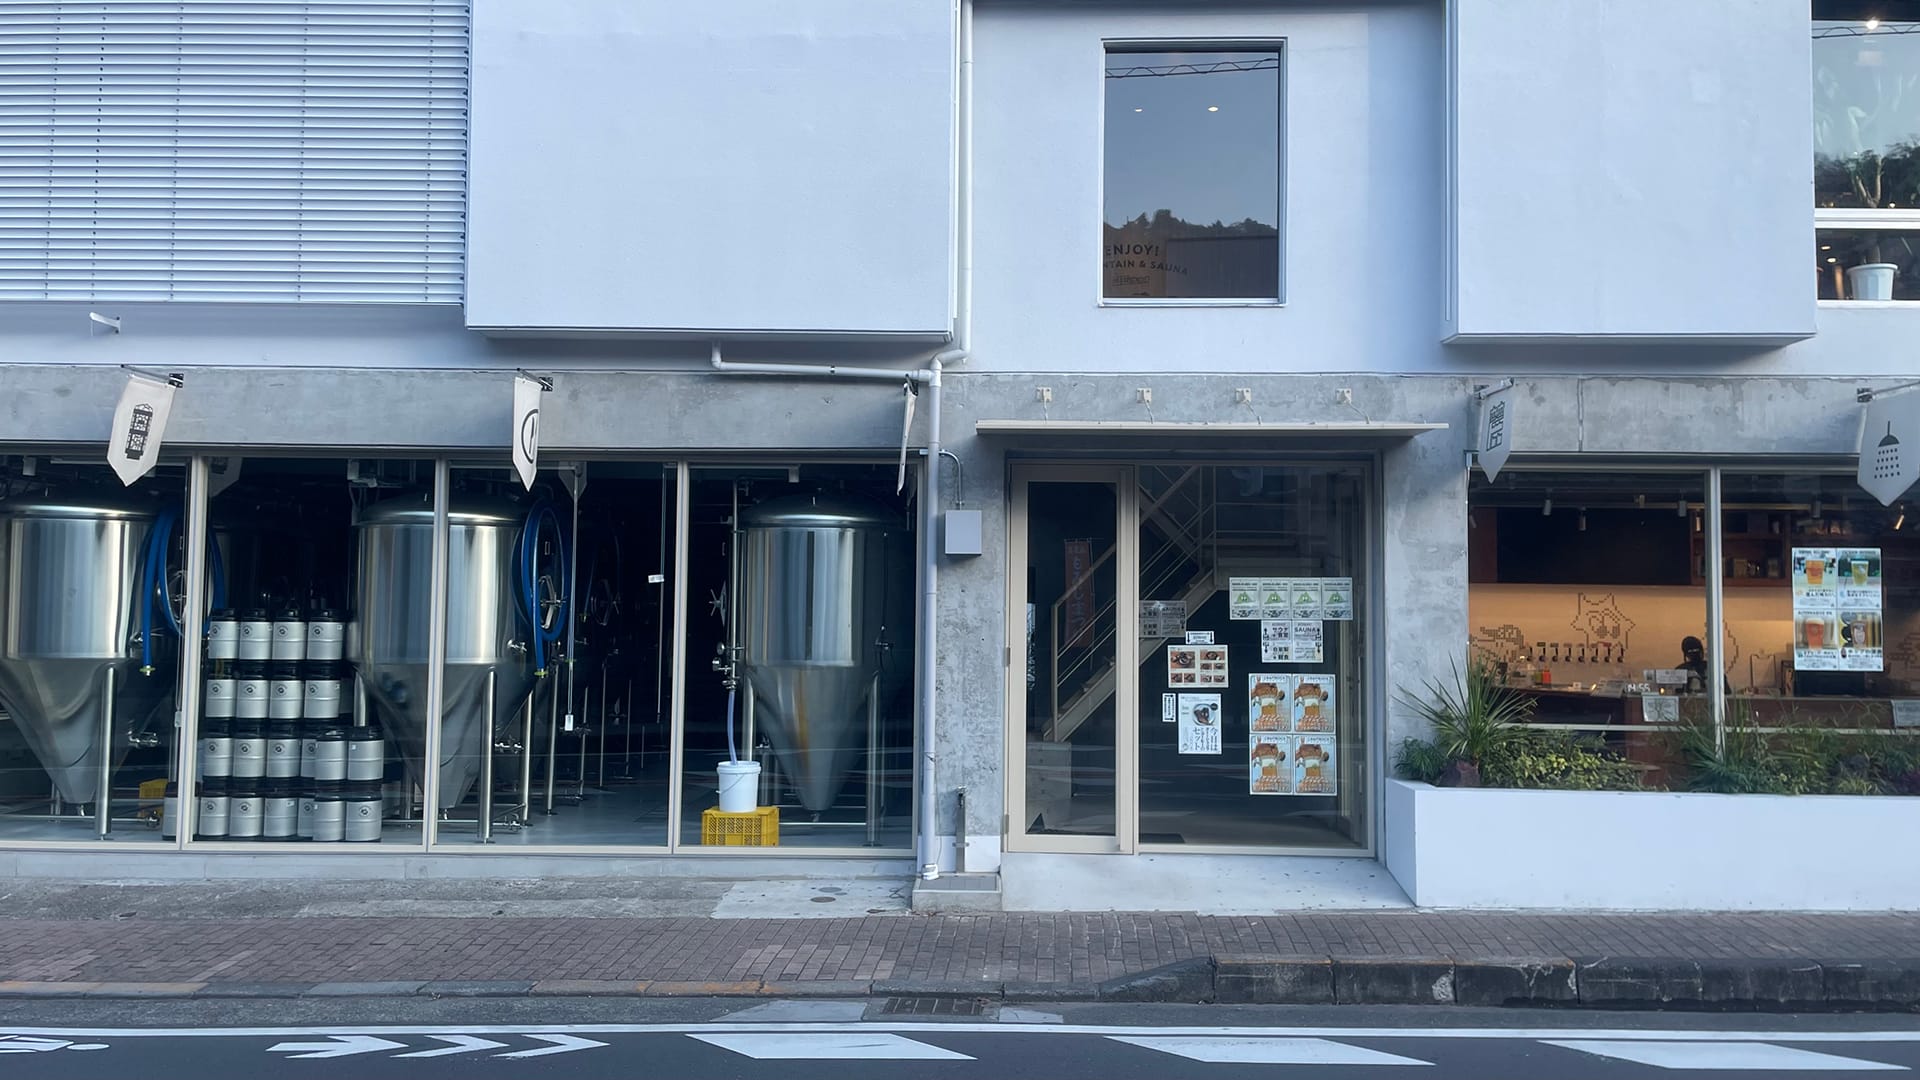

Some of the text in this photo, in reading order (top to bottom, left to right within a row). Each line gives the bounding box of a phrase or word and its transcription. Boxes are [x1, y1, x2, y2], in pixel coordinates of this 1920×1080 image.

[1105, 244, 1159, 257] ENJOY!
[1139, 260, 1146, 269] &
[1150, 261, 1188, 274] SAUNA
[1192, 726, 1200, 751] セット
